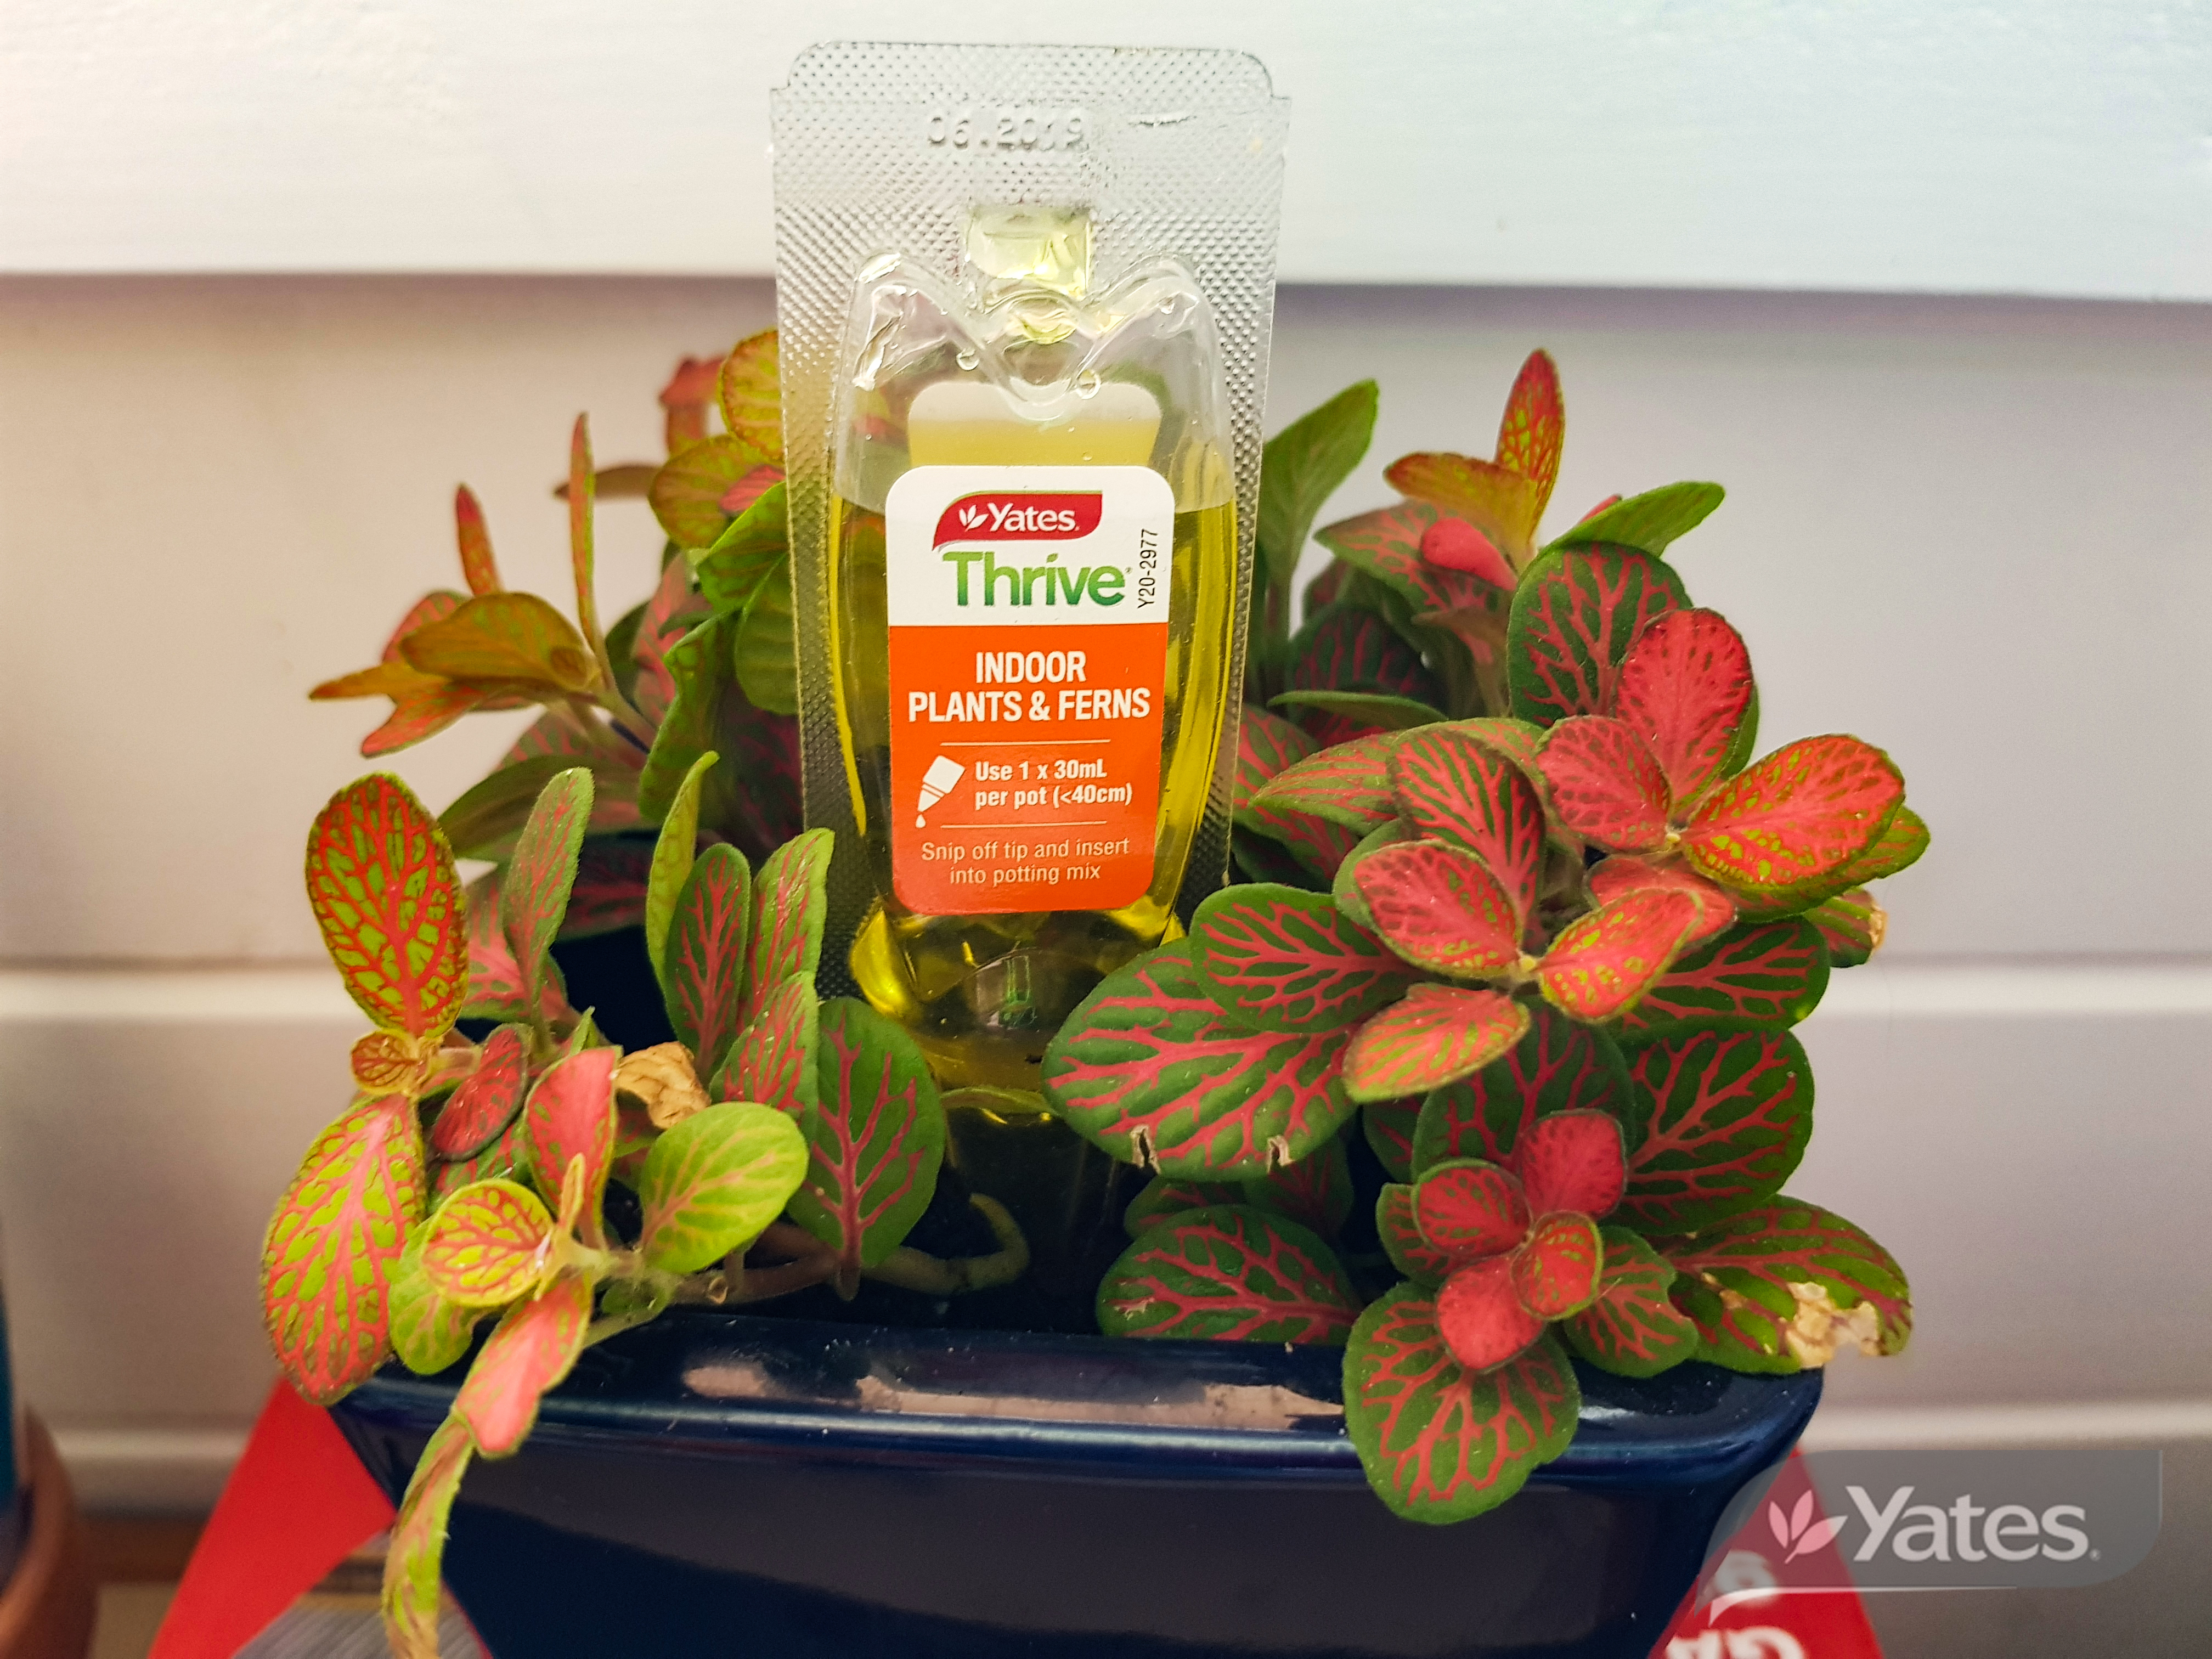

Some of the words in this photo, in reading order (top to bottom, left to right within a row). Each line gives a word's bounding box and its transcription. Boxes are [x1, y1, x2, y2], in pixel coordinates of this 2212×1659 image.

[988, 501, 1076, 533] Yates
[943, 551, 1126, 607] Thrive
[1137, 528, 1159, 609] Y20-2977
[976, 651, 1086, 684] INDOOR
[909, 691, 1022, 723] PLANTS
[1029, 690, 1051, 721] &
[1058, 687, 1150, 719] FERNS
[975, 761, 1012, 781] Use
[1019, 761, 1029, 779] 1
[1037, 764, 1048, 779] x
[1054, 758, 1108, 778] 30mL
[975, 790, 1008, 811] per
[1014, 788, 1047, 809] pot
[1053, 783, 1132, 808] (<40cm)
[921, 842, 965, 863] Snip
[972, 841, 998, 860] off
[1004, 840, 1028, 862] tip
[1034, 839, 1069, 857] and
[1076, 837, 1130, 856] insert
[950, 866, 986, 884] into
[993, 864, 1059, 887] potting
[1066, 862, 1101, 881] mix
